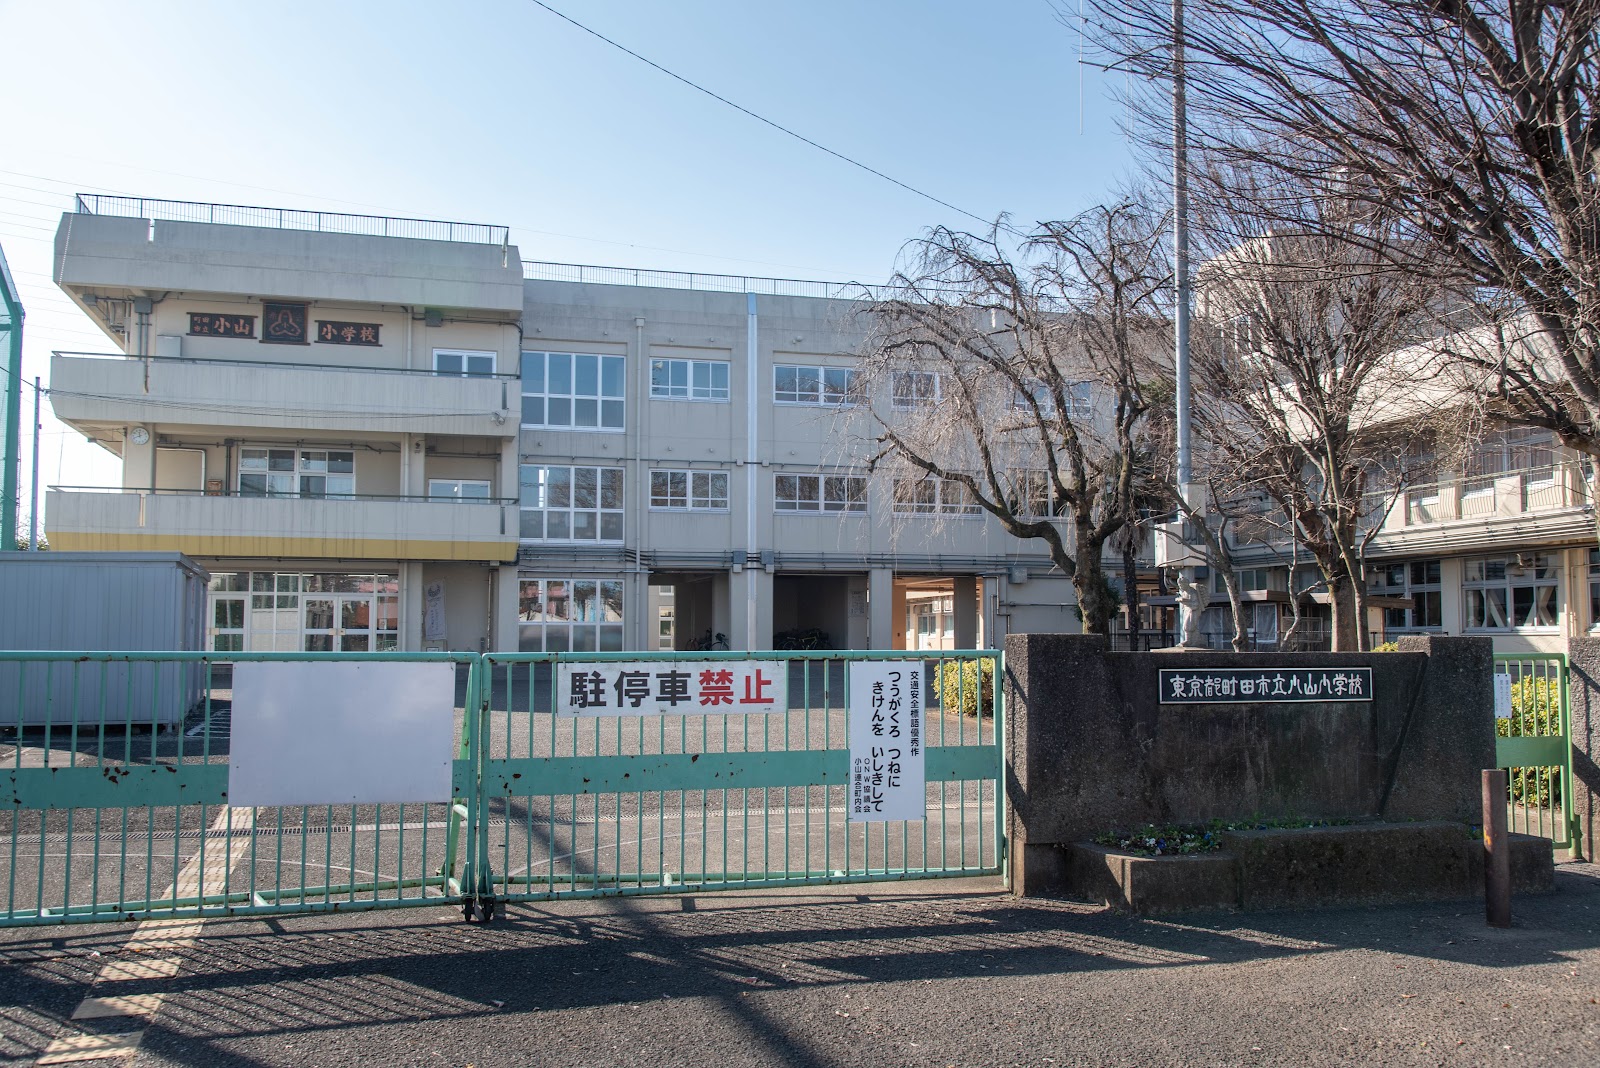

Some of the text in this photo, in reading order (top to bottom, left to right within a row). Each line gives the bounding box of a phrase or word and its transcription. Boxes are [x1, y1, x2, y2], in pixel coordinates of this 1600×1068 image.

[213, 317, 250, 335] 小山
[321, 324, 377, 343] 小学校
[569, 669, 775, 708] 駐停車禁止
[1169, 673, 1363, 698] 東京都町田市立小山小学校
[888, 671, 903, 788] つうがくろ つねに
[910, 671, 920, 757] 交通安全標語優秀作
[871, 681, 885, 812] きけんを いしきして
[854, 757, 862, 813] 小山連合町内会
